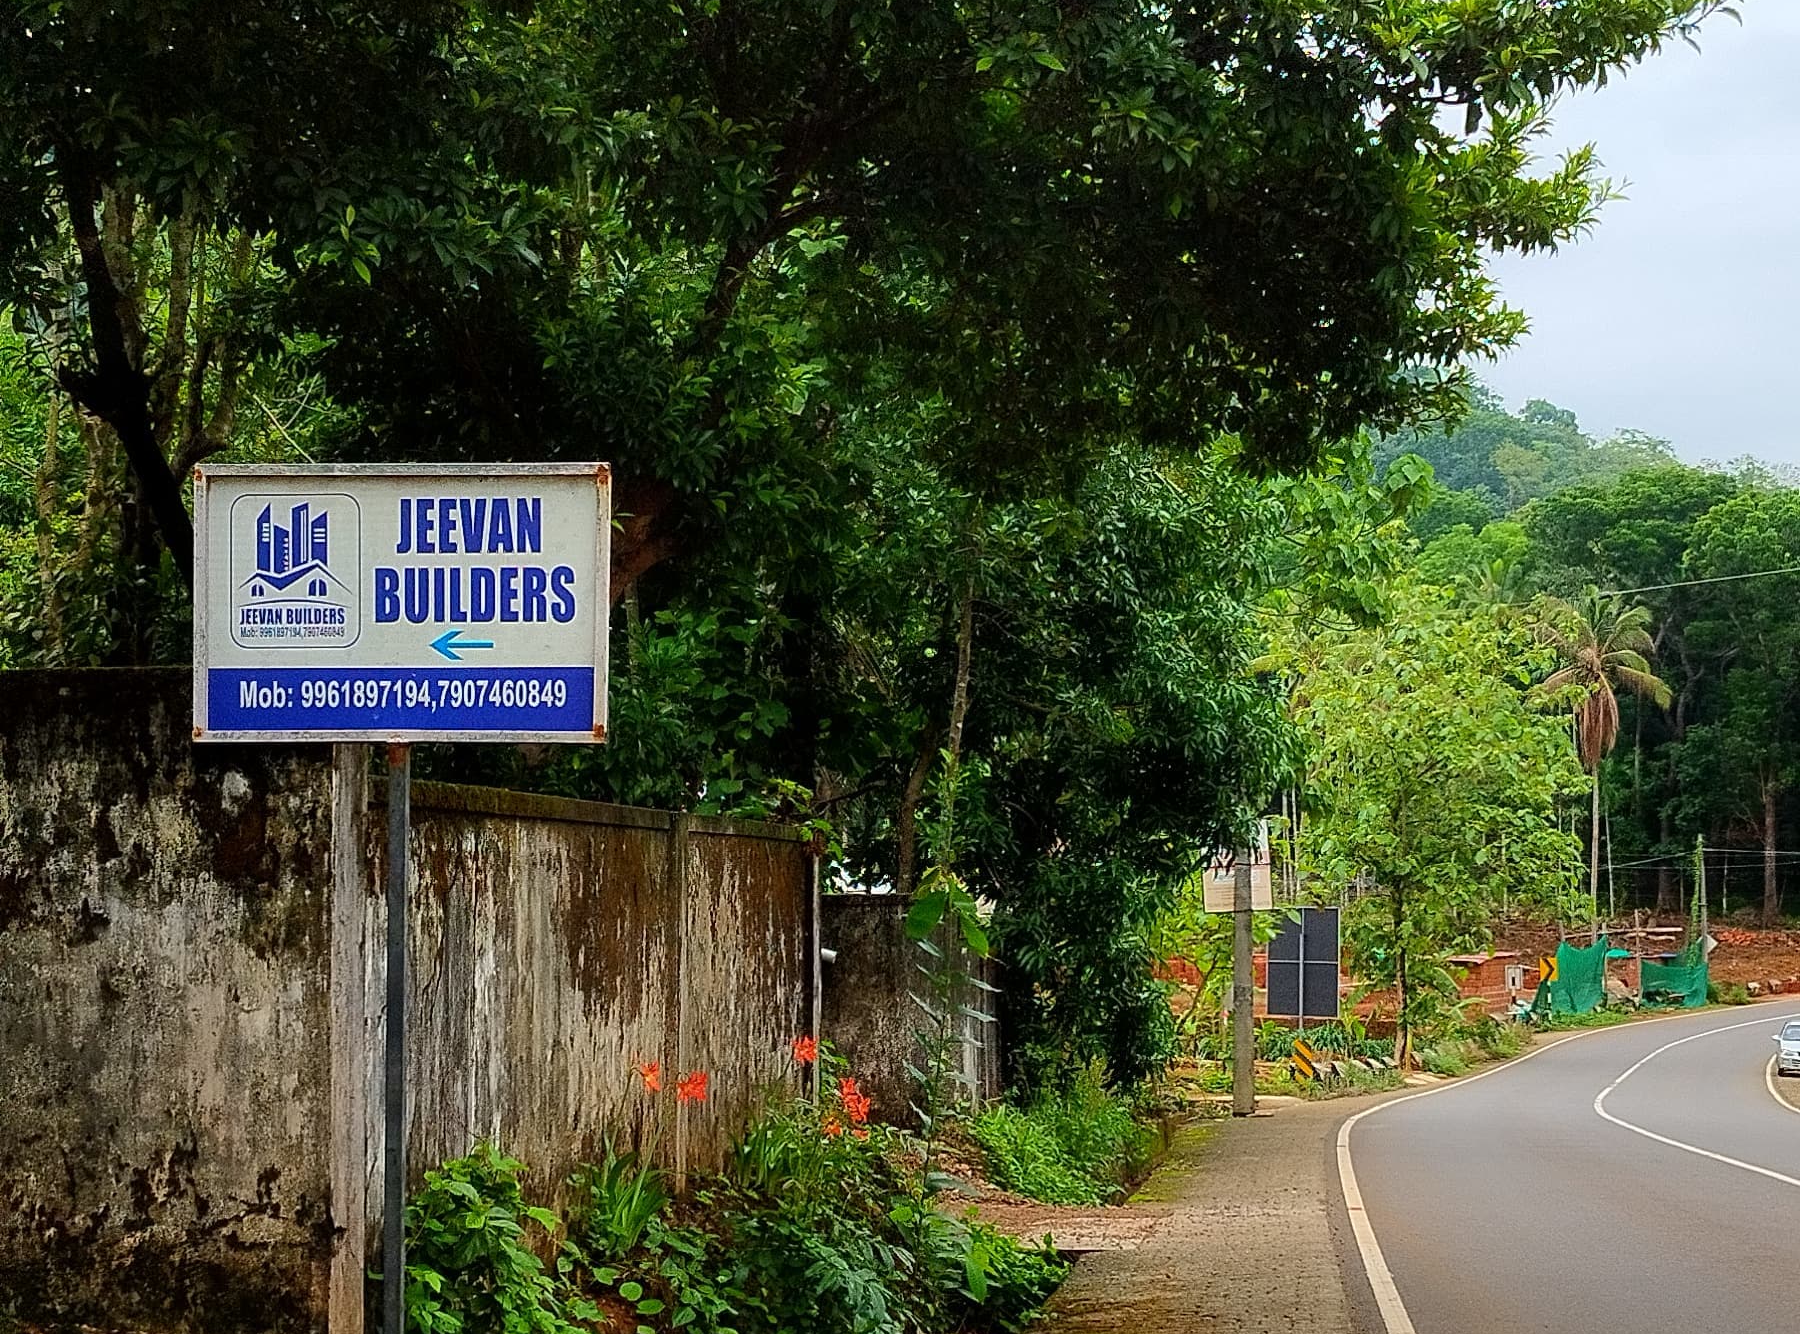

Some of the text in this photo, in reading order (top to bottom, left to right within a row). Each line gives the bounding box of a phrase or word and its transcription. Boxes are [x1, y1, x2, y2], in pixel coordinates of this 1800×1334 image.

[396, 497, 541, 554] JEEVAN
[374, 566, 576, 623] BUILDERS
[240, 608, 345, 625] JEEVAN BUILDERS
[240, 627, 258, 638] Mob:
[239, 679, 567, 713] Mob: 9961897194,7907460849
